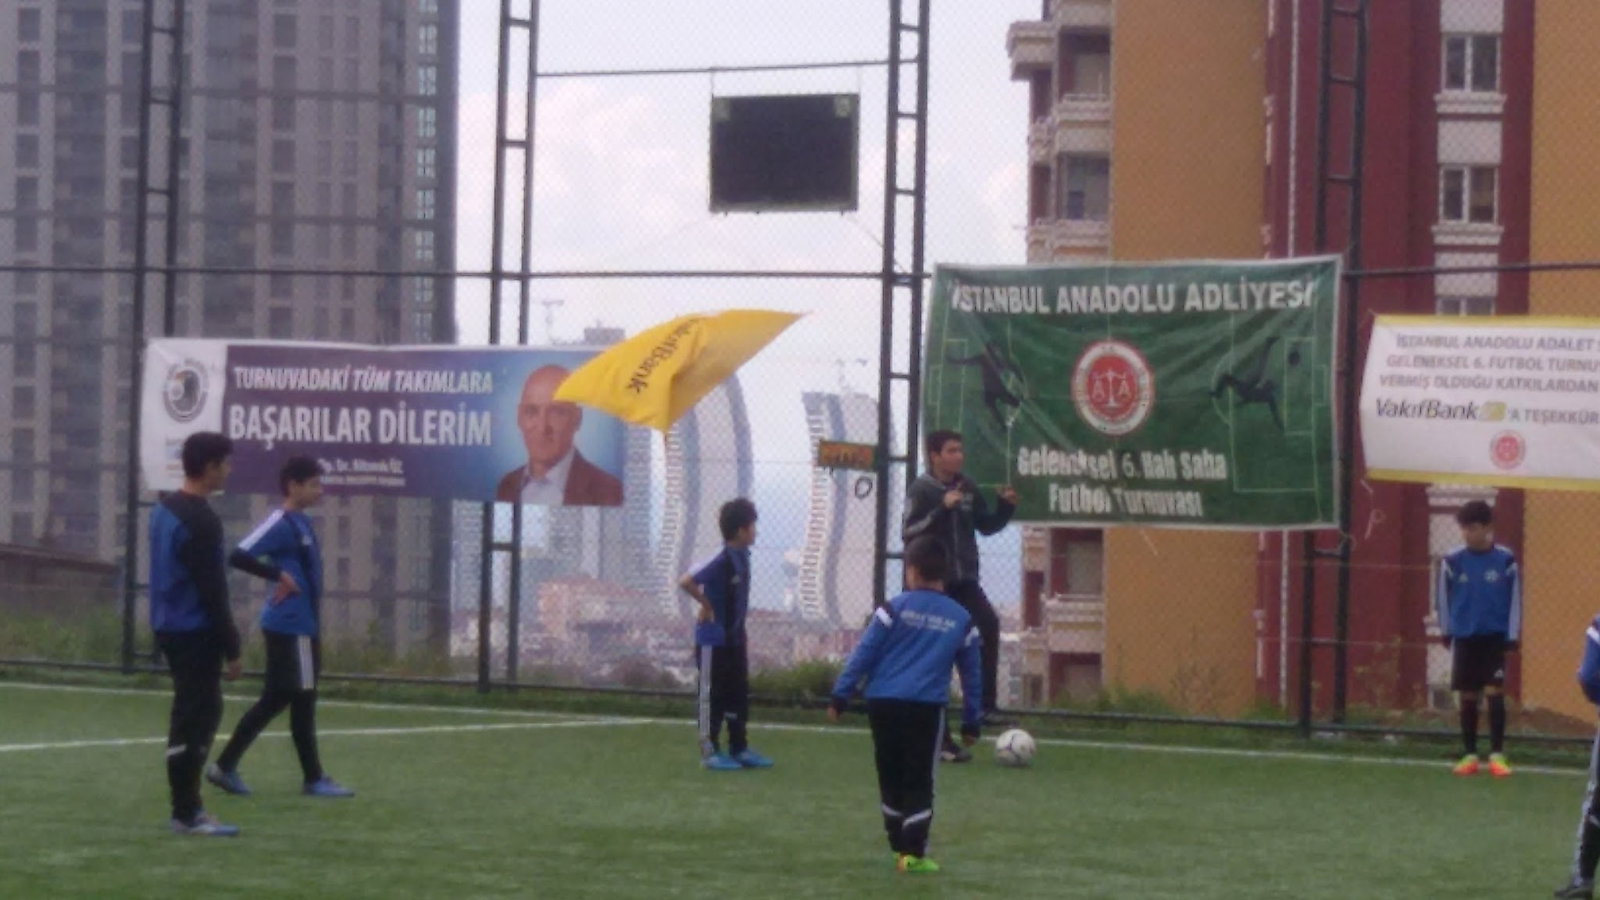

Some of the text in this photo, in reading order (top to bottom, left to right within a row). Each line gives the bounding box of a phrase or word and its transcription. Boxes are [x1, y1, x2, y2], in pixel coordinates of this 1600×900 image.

[951, 274, 1314, 313] İSTANBUL ANADOLU ADLİYESİ
[1463, 336, 1533, 350] ANADOLU
[1536, 337, 1595, 351] ADALET
[234, 363, 492, 394] TURNUVADAKİ TÜM TAKIMLARA
[1386, 355, 1469, 369] GELENEKSEL
[1489, 357, 1544, 371] FUTBOL
[1434, 374, 1492, 389] OLDUĞU
[1496, 377, 1599, 392] KATKILARDAN
[229, 400, 491, 450] BAŞARILAR DİLERİM
[1179, 448, 1227, 480] Saha
[1049, 483, 1203, 517] Futbol Turnuvası
